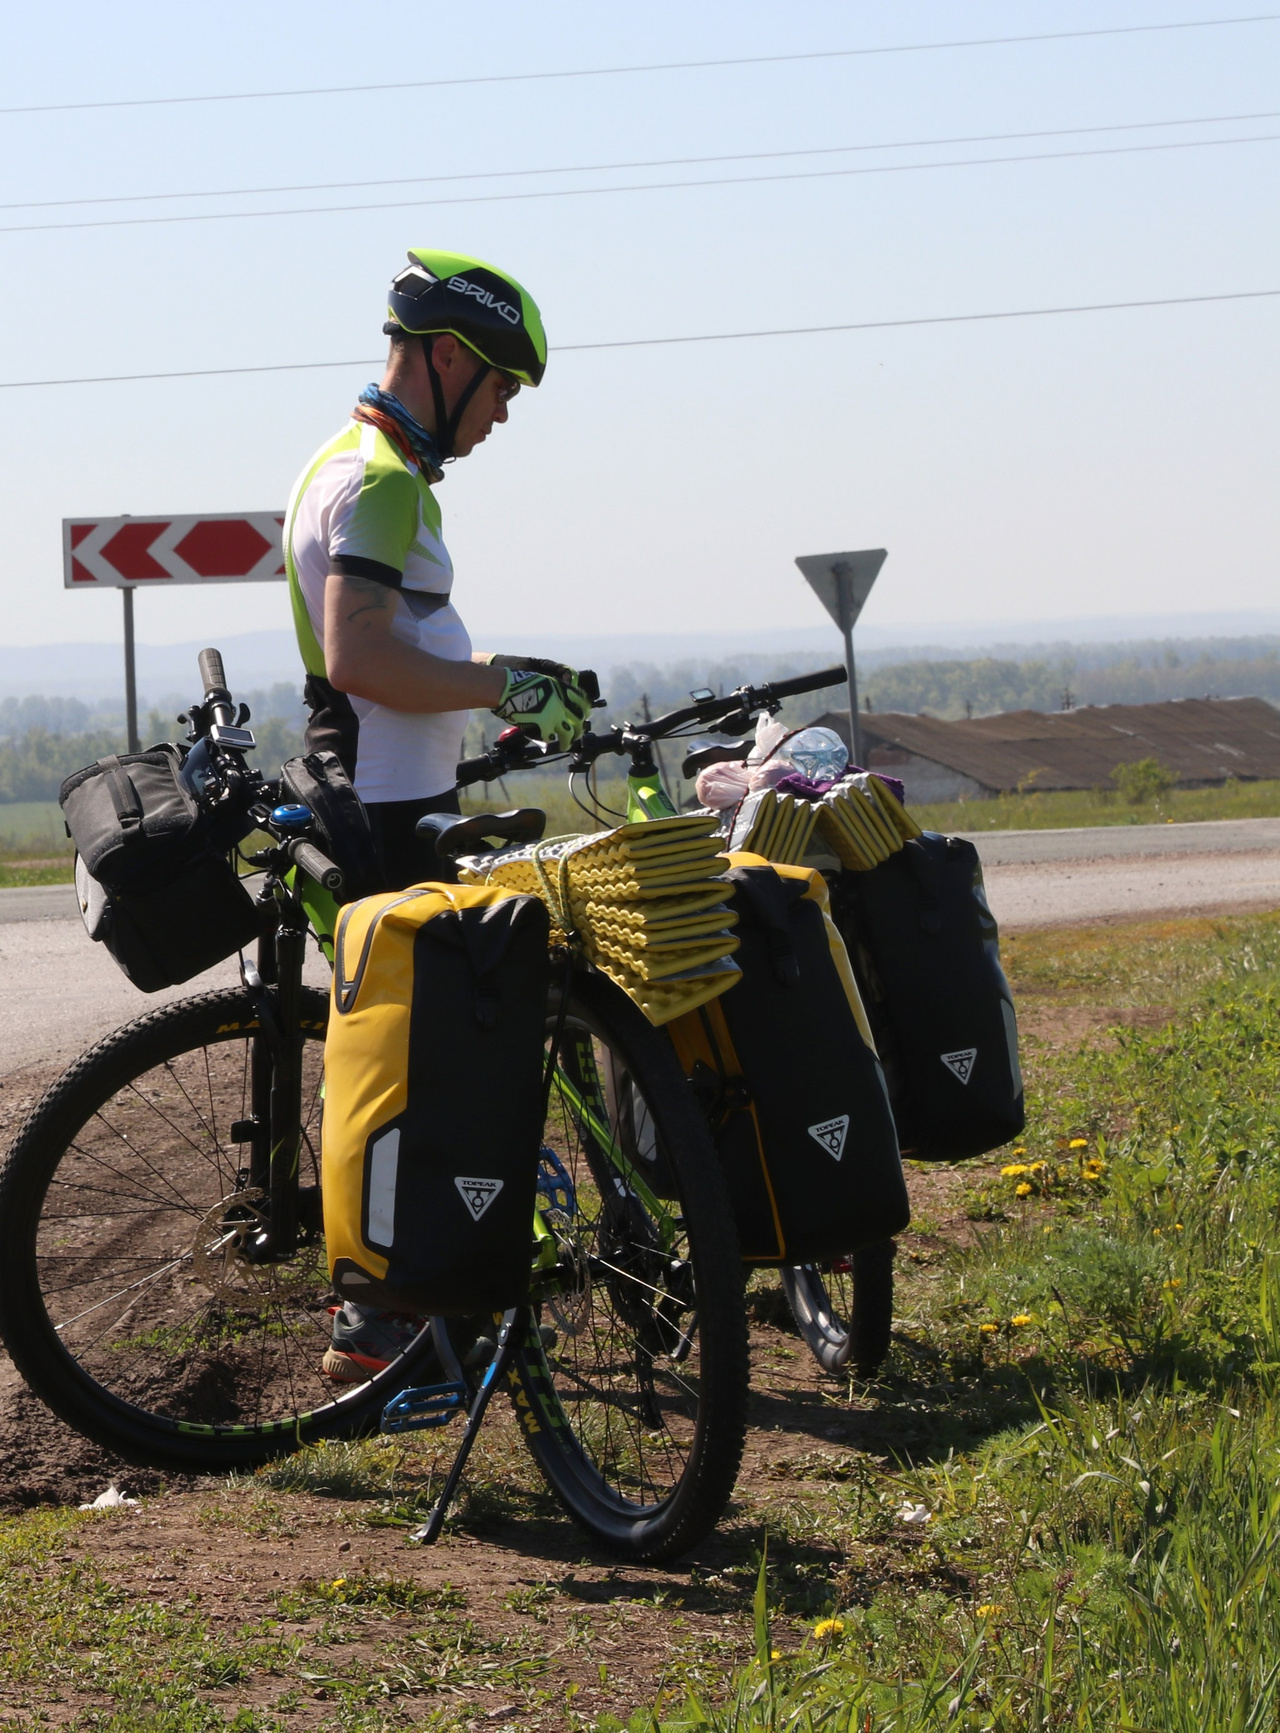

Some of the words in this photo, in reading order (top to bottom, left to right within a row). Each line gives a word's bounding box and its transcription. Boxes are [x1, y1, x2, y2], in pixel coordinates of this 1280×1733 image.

[447, 276, 520, 325] BRIKO
[815, 1119, 845, 1133] TOPEAK
[461, 1180, 497, 1188] TOPEAK
[492, 1311, 541, 1434] MAXS
